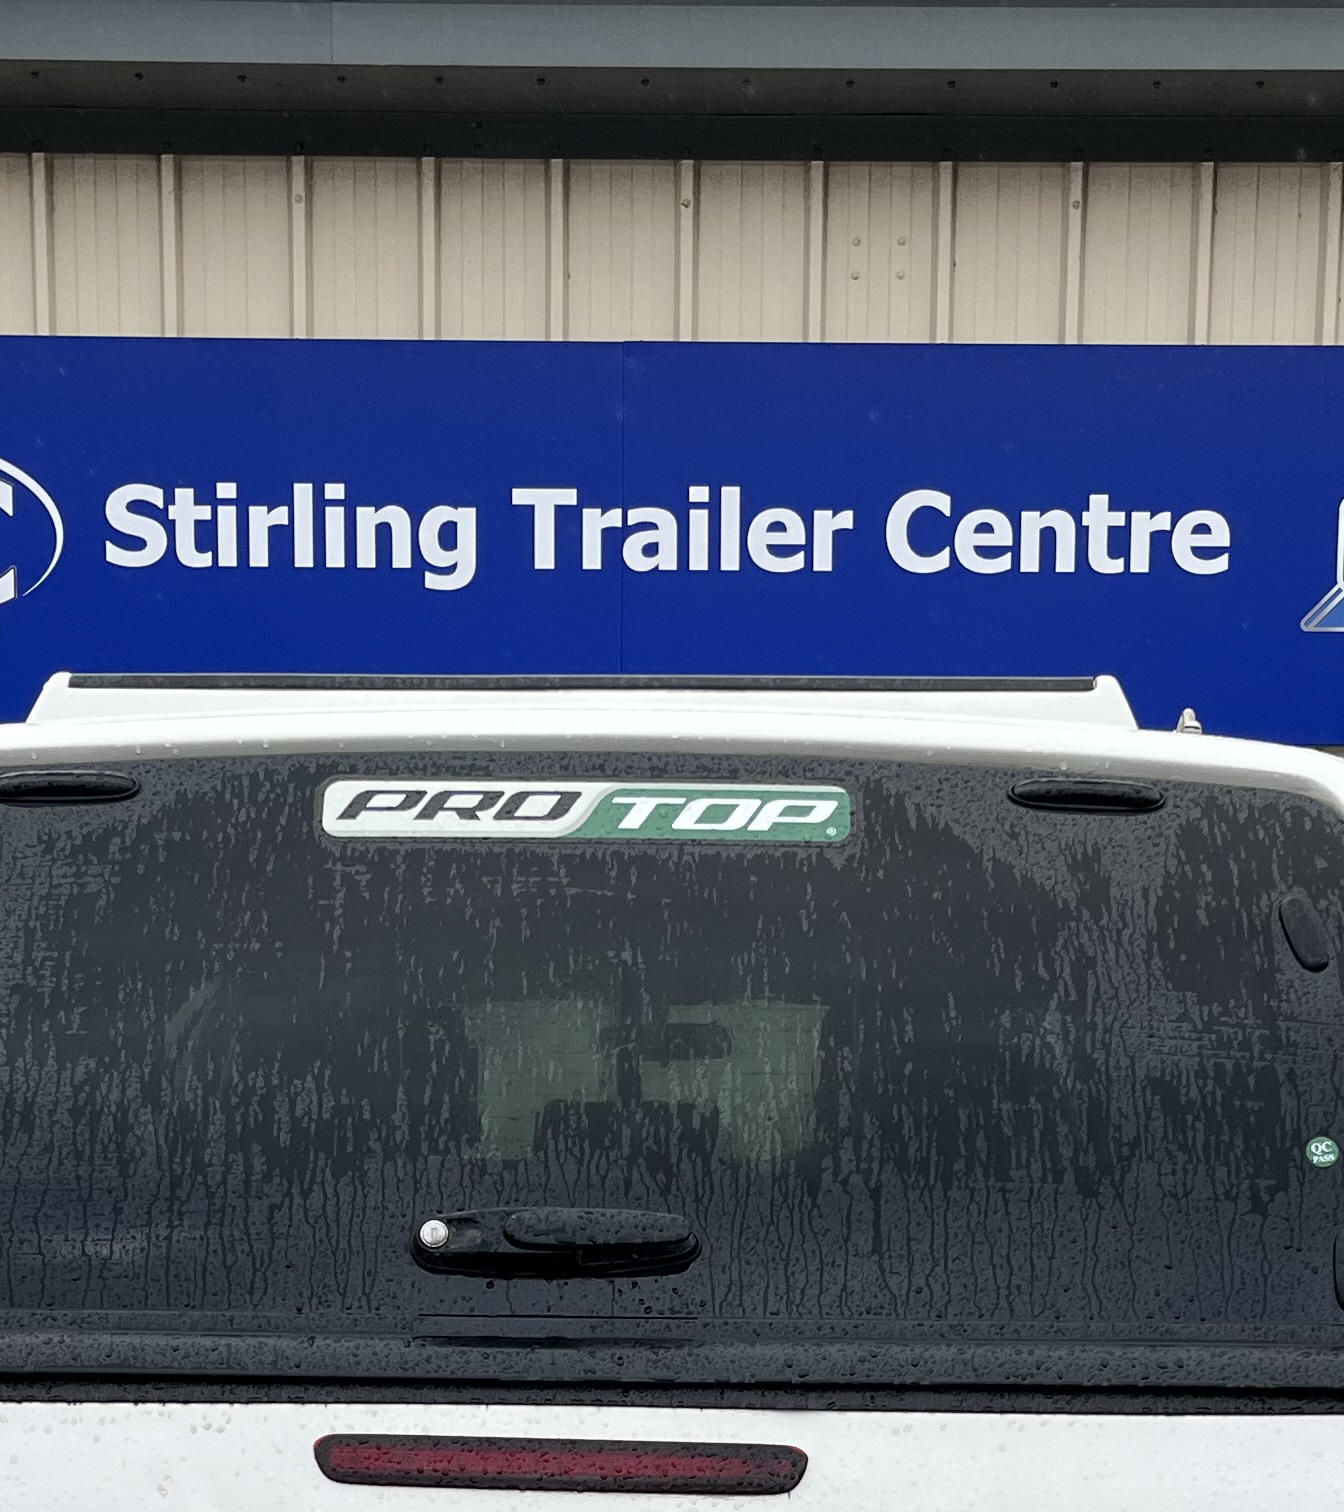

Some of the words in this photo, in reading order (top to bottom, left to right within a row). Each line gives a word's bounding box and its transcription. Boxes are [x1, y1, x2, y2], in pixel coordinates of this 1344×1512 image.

[105, 482, 476, 591] Stirling
[512, 485, 854, 573] Trailer
[885, 488, 1231, 574] Centre
[337, 789, 583, 821] PRO
[611, 796, 840, 832] TOP
[1310, 1141, 1333, 1156] QC
[1312, 1153, 1336, 1164] PASS
